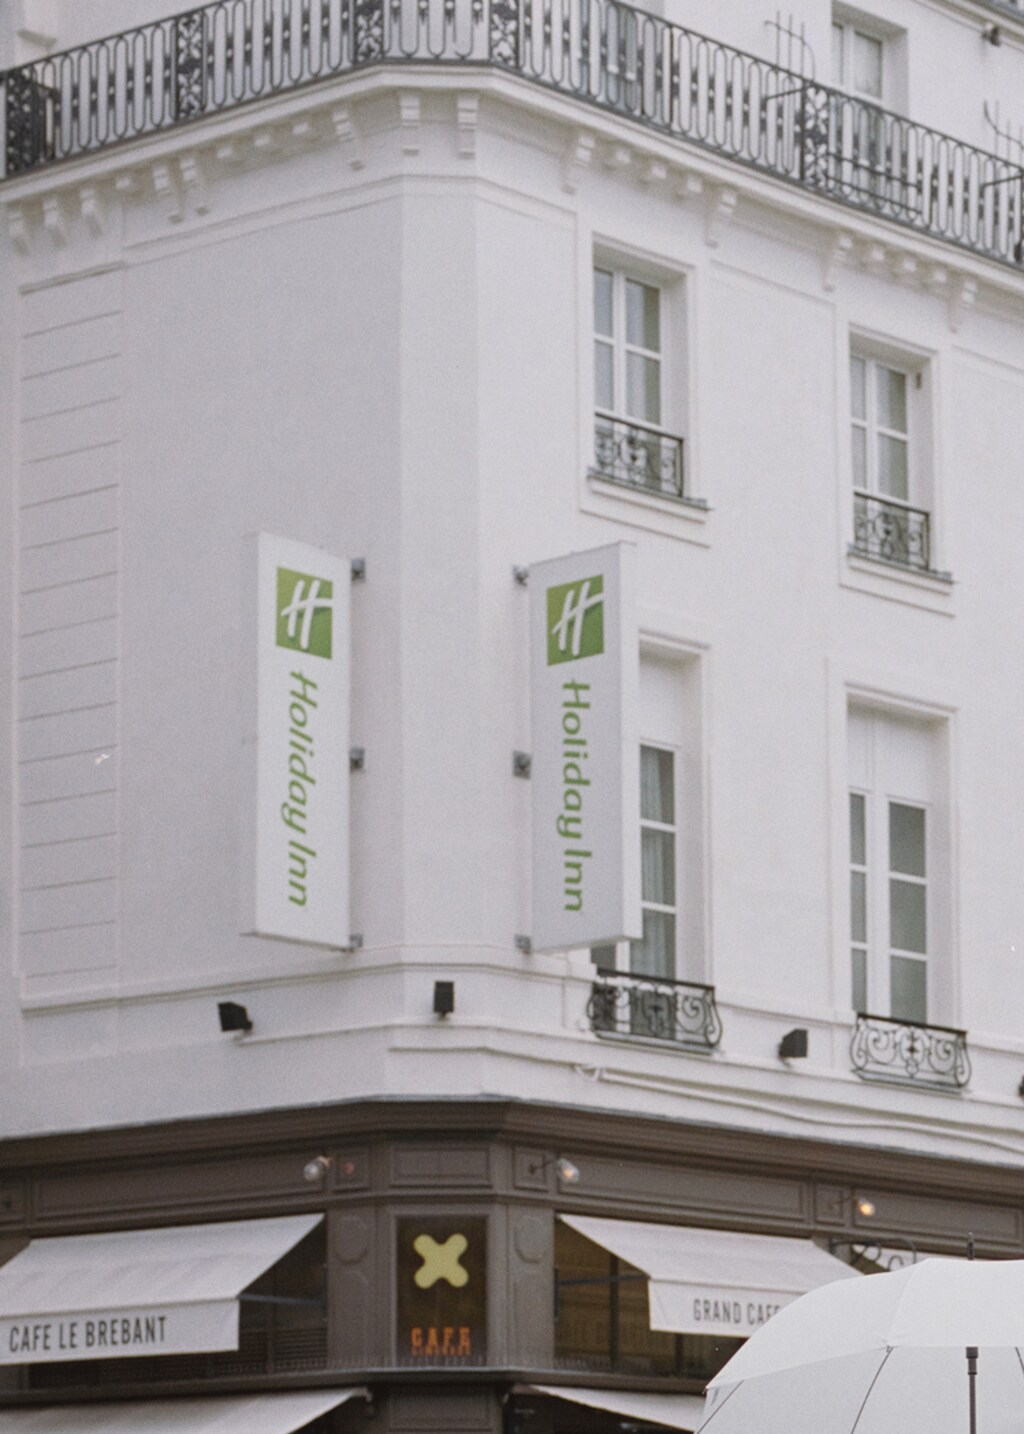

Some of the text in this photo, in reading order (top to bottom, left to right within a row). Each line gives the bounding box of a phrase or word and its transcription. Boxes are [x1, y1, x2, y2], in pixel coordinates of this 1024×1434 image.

[281, 671, 318, 906] Holiday Inn
[556, 679, 593, 911] Holiday Inn
[9, 1316, 166, 1353] CAFE LE BREBANT
[693, 1299, 742, 1325] GRAND
